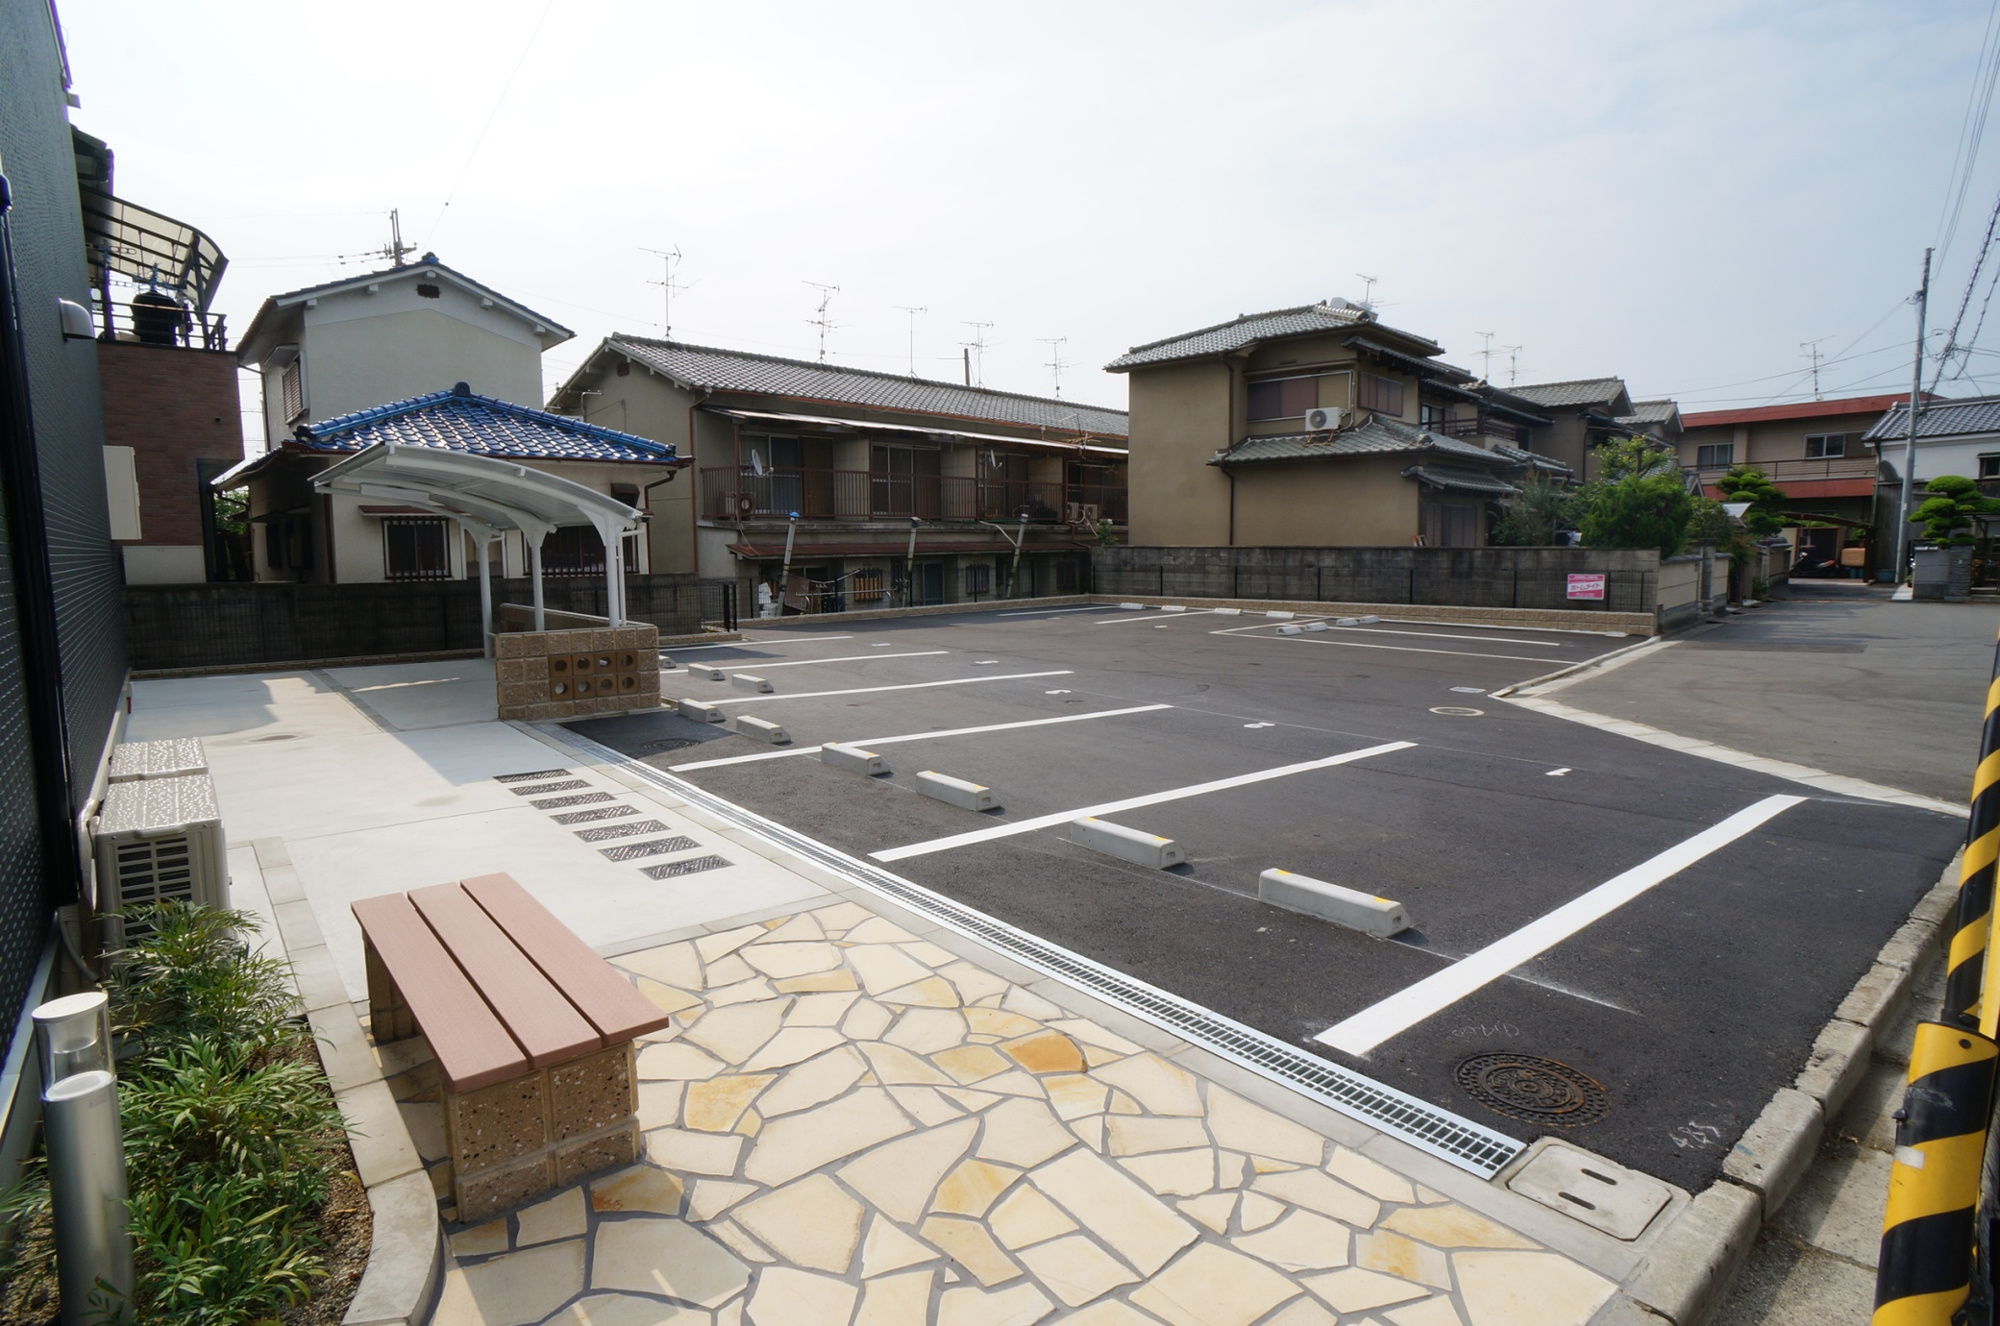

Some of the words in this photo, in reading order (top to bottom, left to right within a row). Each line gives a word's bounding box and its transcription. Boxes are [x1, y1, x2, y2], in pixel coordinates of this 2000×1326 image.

[1570, 582, 1602, 591] ホームメイト
